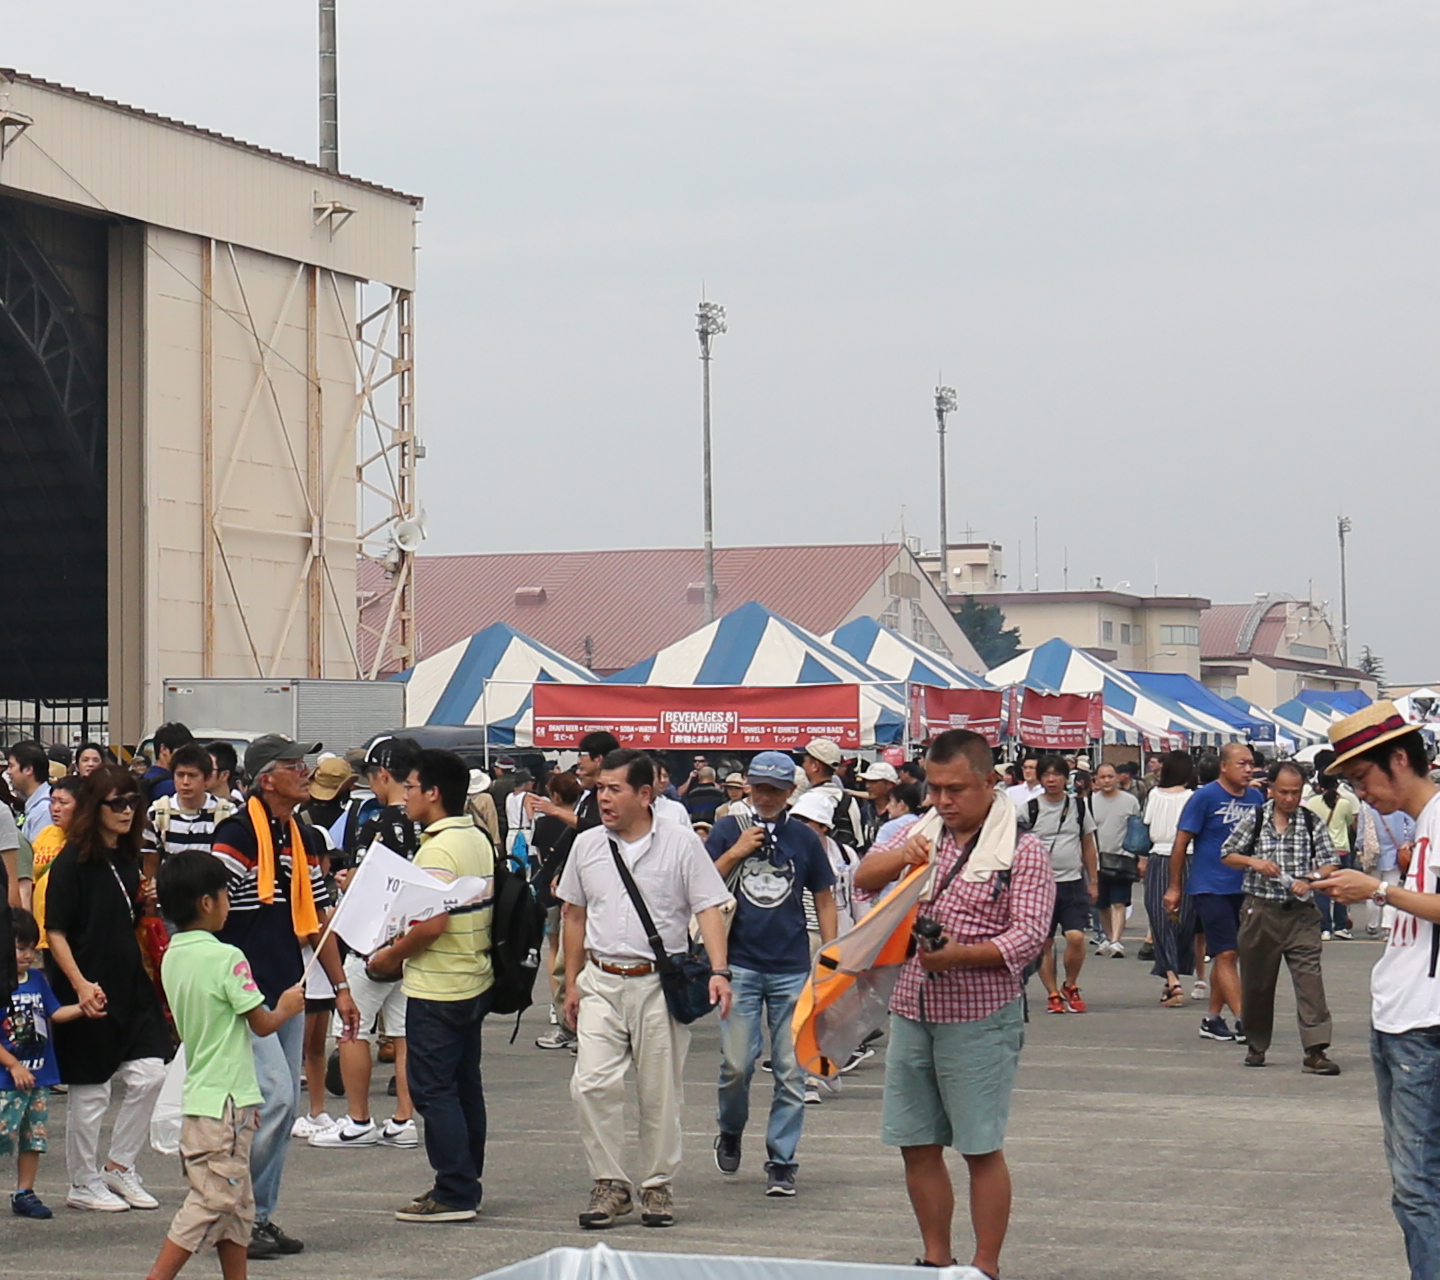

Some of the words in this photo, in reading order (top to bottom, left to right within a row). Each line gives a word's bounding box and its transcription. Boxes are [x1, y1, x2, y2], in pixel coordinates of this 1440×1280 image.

[665, 711, 725, 723] BEVERAGES
[725, 711, 734, 723] &
[670, 722, 729, 733] SOUVENIRS
[233, 960, 257, 991] 3
